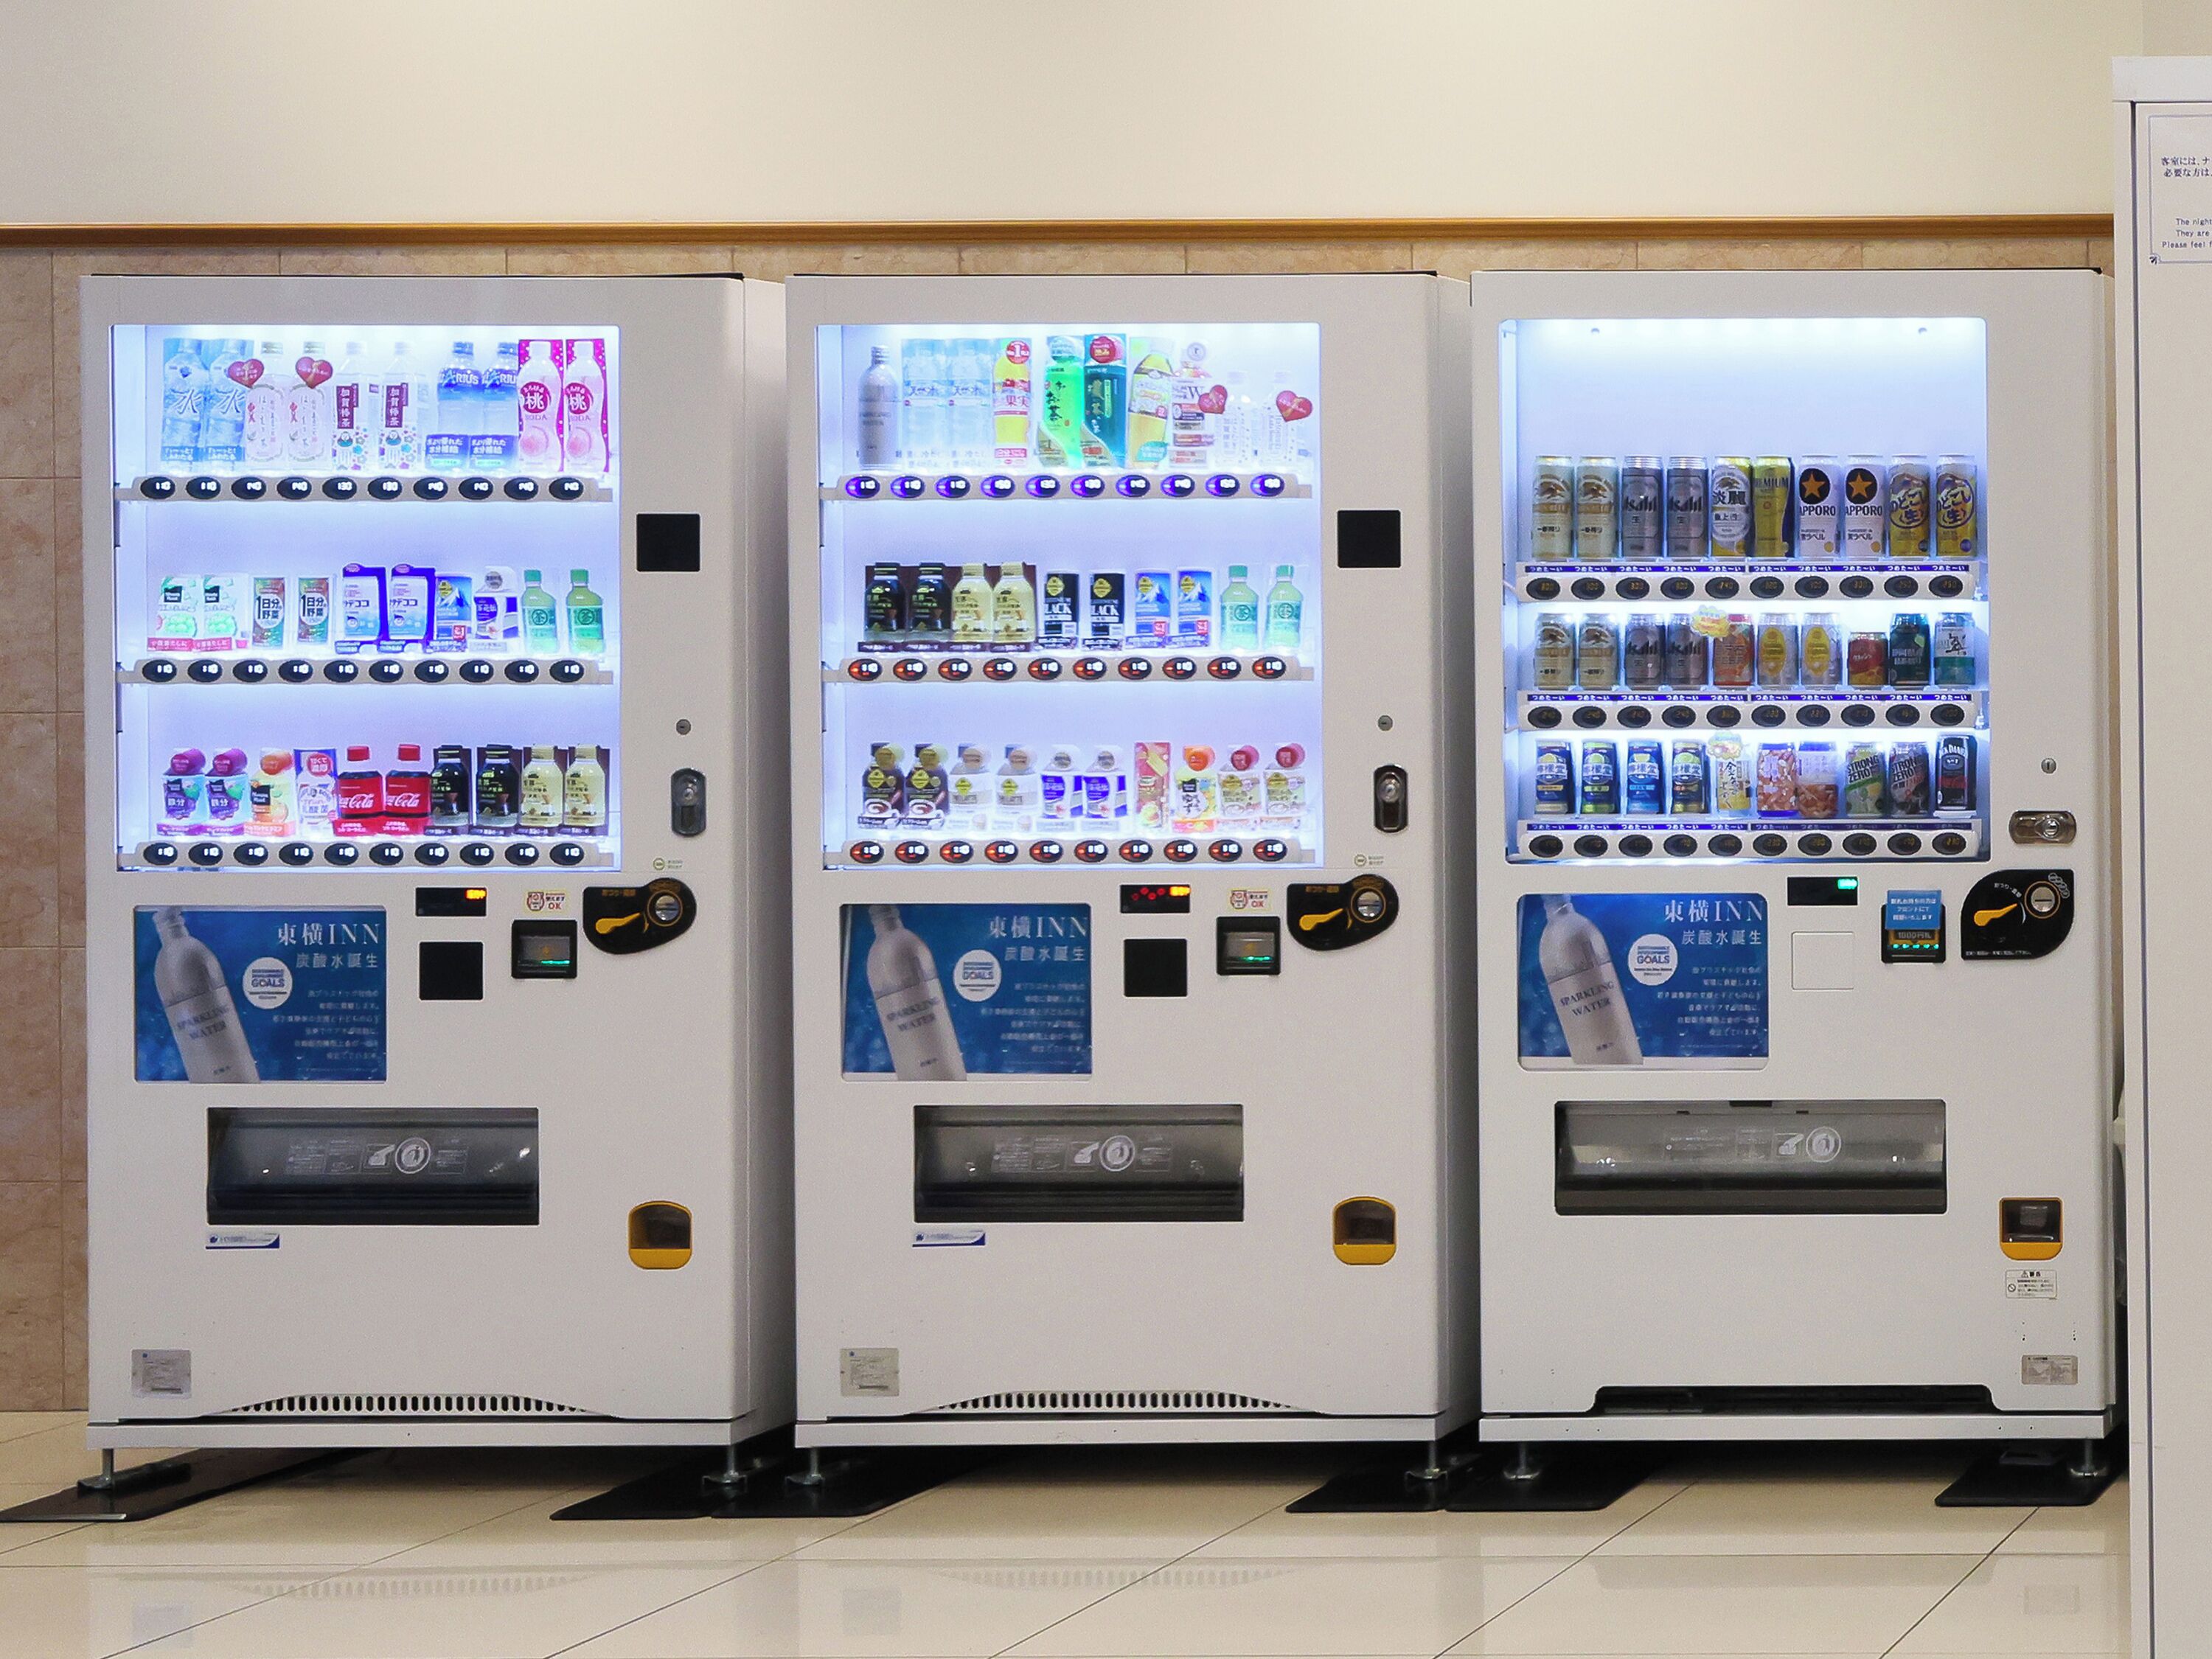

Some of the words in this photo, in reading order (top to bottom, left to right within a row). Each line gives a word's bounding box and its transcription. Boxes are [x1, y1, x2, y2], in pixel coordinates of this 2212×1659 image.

[2176, 229, 2194, 237] They
[526, 393, 544, 410] 桃
[569, 394, 587, 411] 桃
[1712, 490, 1747, 506] 淡麗
[262, 610, 279, 619] 野菜
[307, 608, 324, 616] 野菜
[1846, 755, 1879, 773] STRONG
[1848, 768, 1871, 783] ZERO
[1893, 768, 1915, 782] ZERO
[1663, 900, 1764, 922] 東横INN
[277, 922, 380, 946] 東横INN
[989, 915, 1088, 939] 東横INN
[1681, 929, 1762, 945] 炭酸水誕生
[1637, 955, 1670, 964] GOALS
[251, 978, 285, 988] GOALS
[1559, 981, 1615, 1006] SPARKLING
[1571, 998, 1611, 1016] WATER
